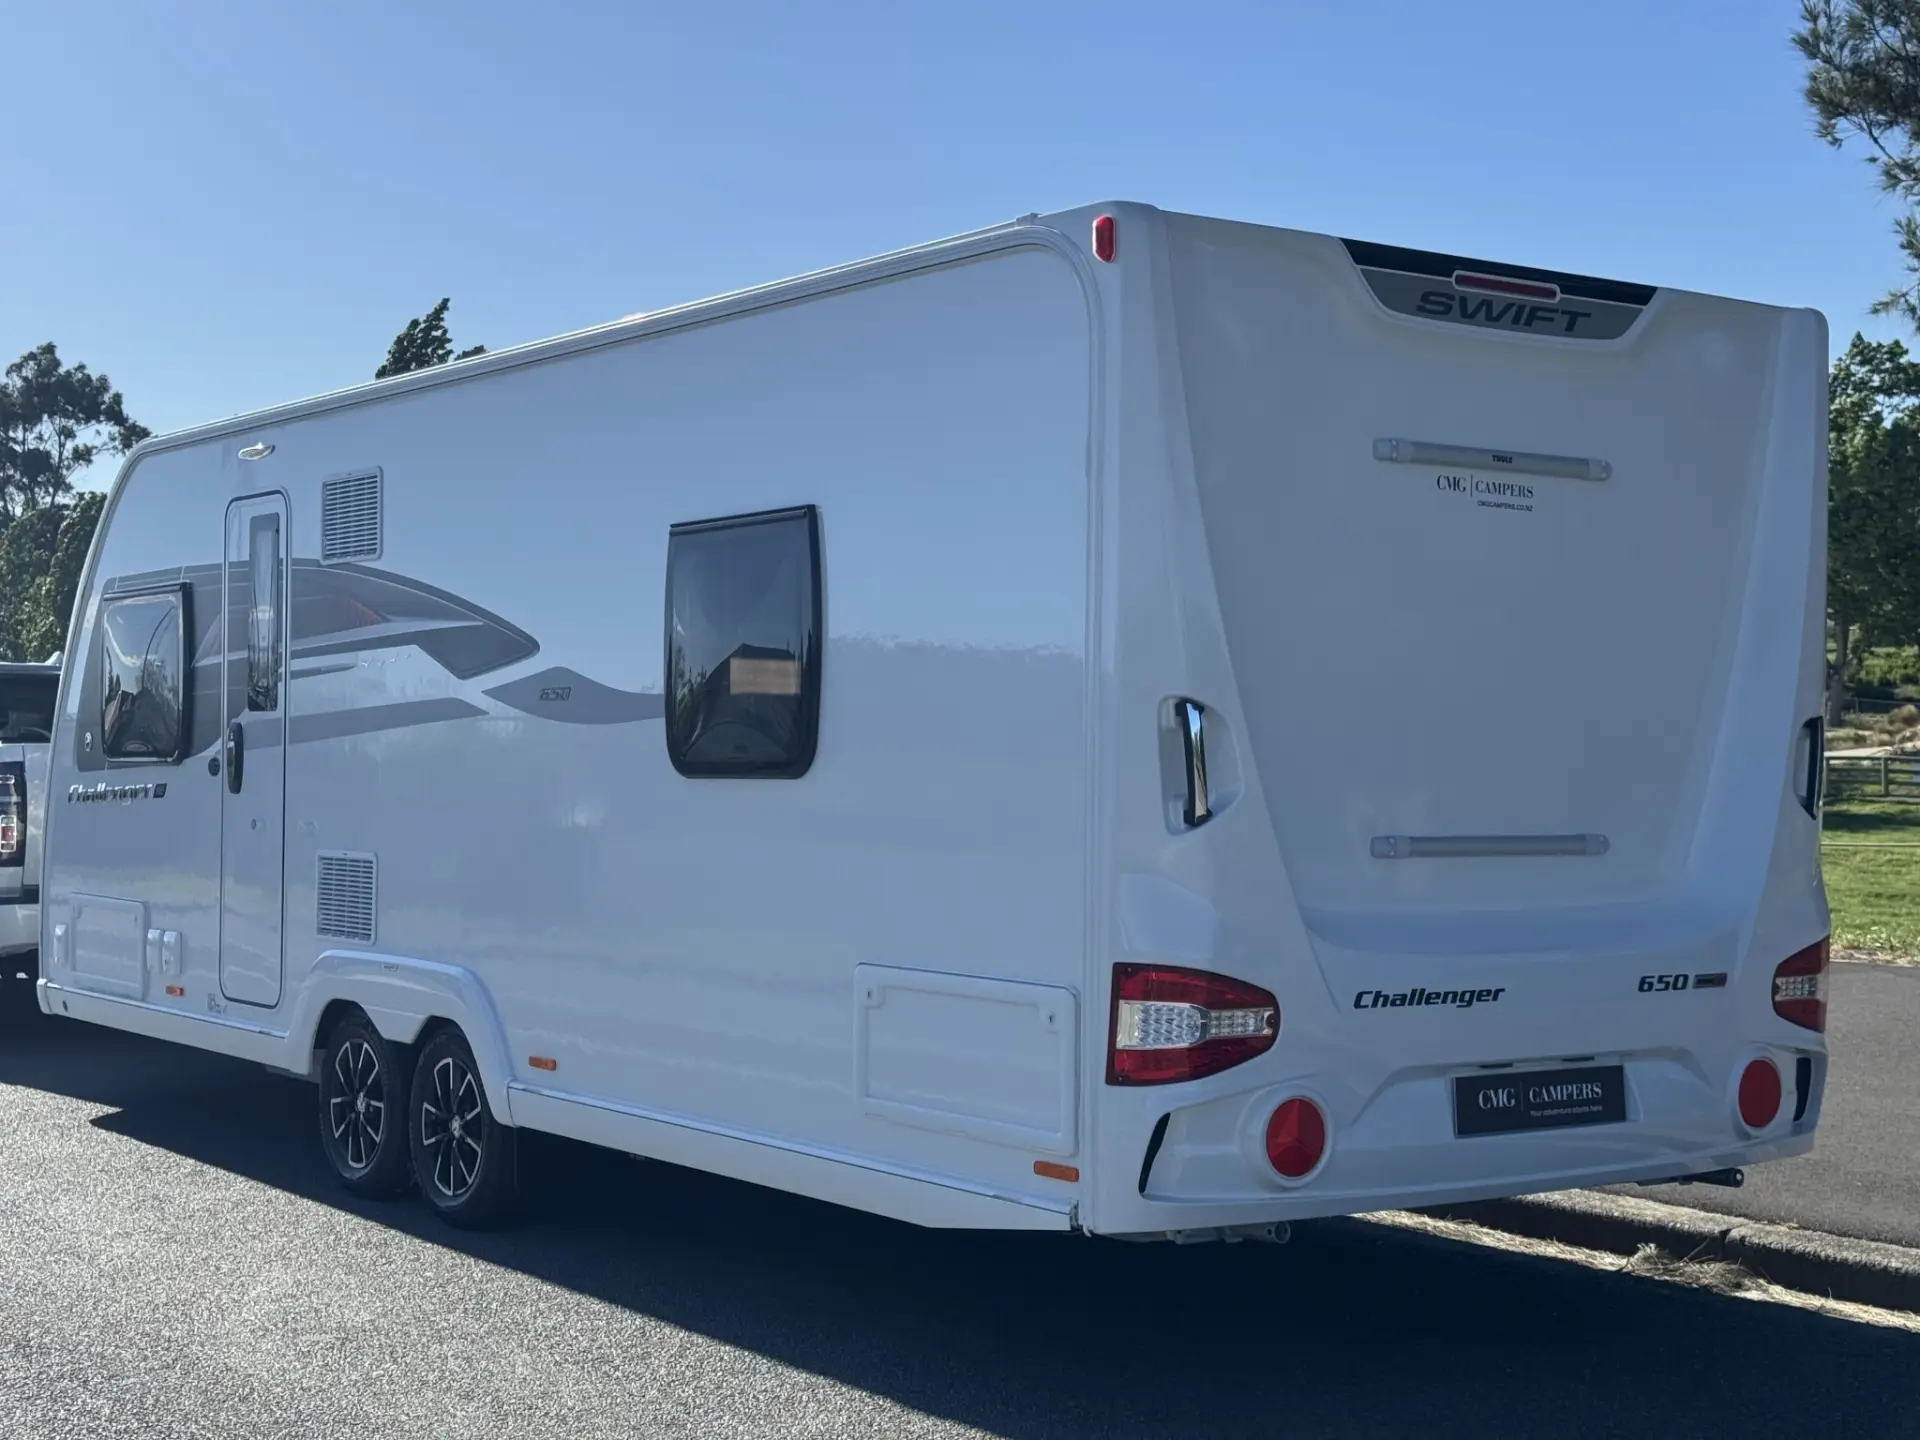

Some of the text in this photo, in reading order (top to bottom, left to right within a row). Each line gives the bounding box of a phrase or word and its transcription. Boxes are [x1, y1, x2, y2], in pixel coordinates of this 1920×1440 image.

[1416, 290, 1592, 333] SWIFT
[1436, 474, 1534, 499] CMG CAMPERS
[540, 686, 571, 701] 650
[68, 782, 153, 805] Challenger
[1637, 973, 1690, 993] 650
[1353, 987, 1506, 1010] Challenger
[1478, 1081, 1602, 1110] CMG CAMPERS
